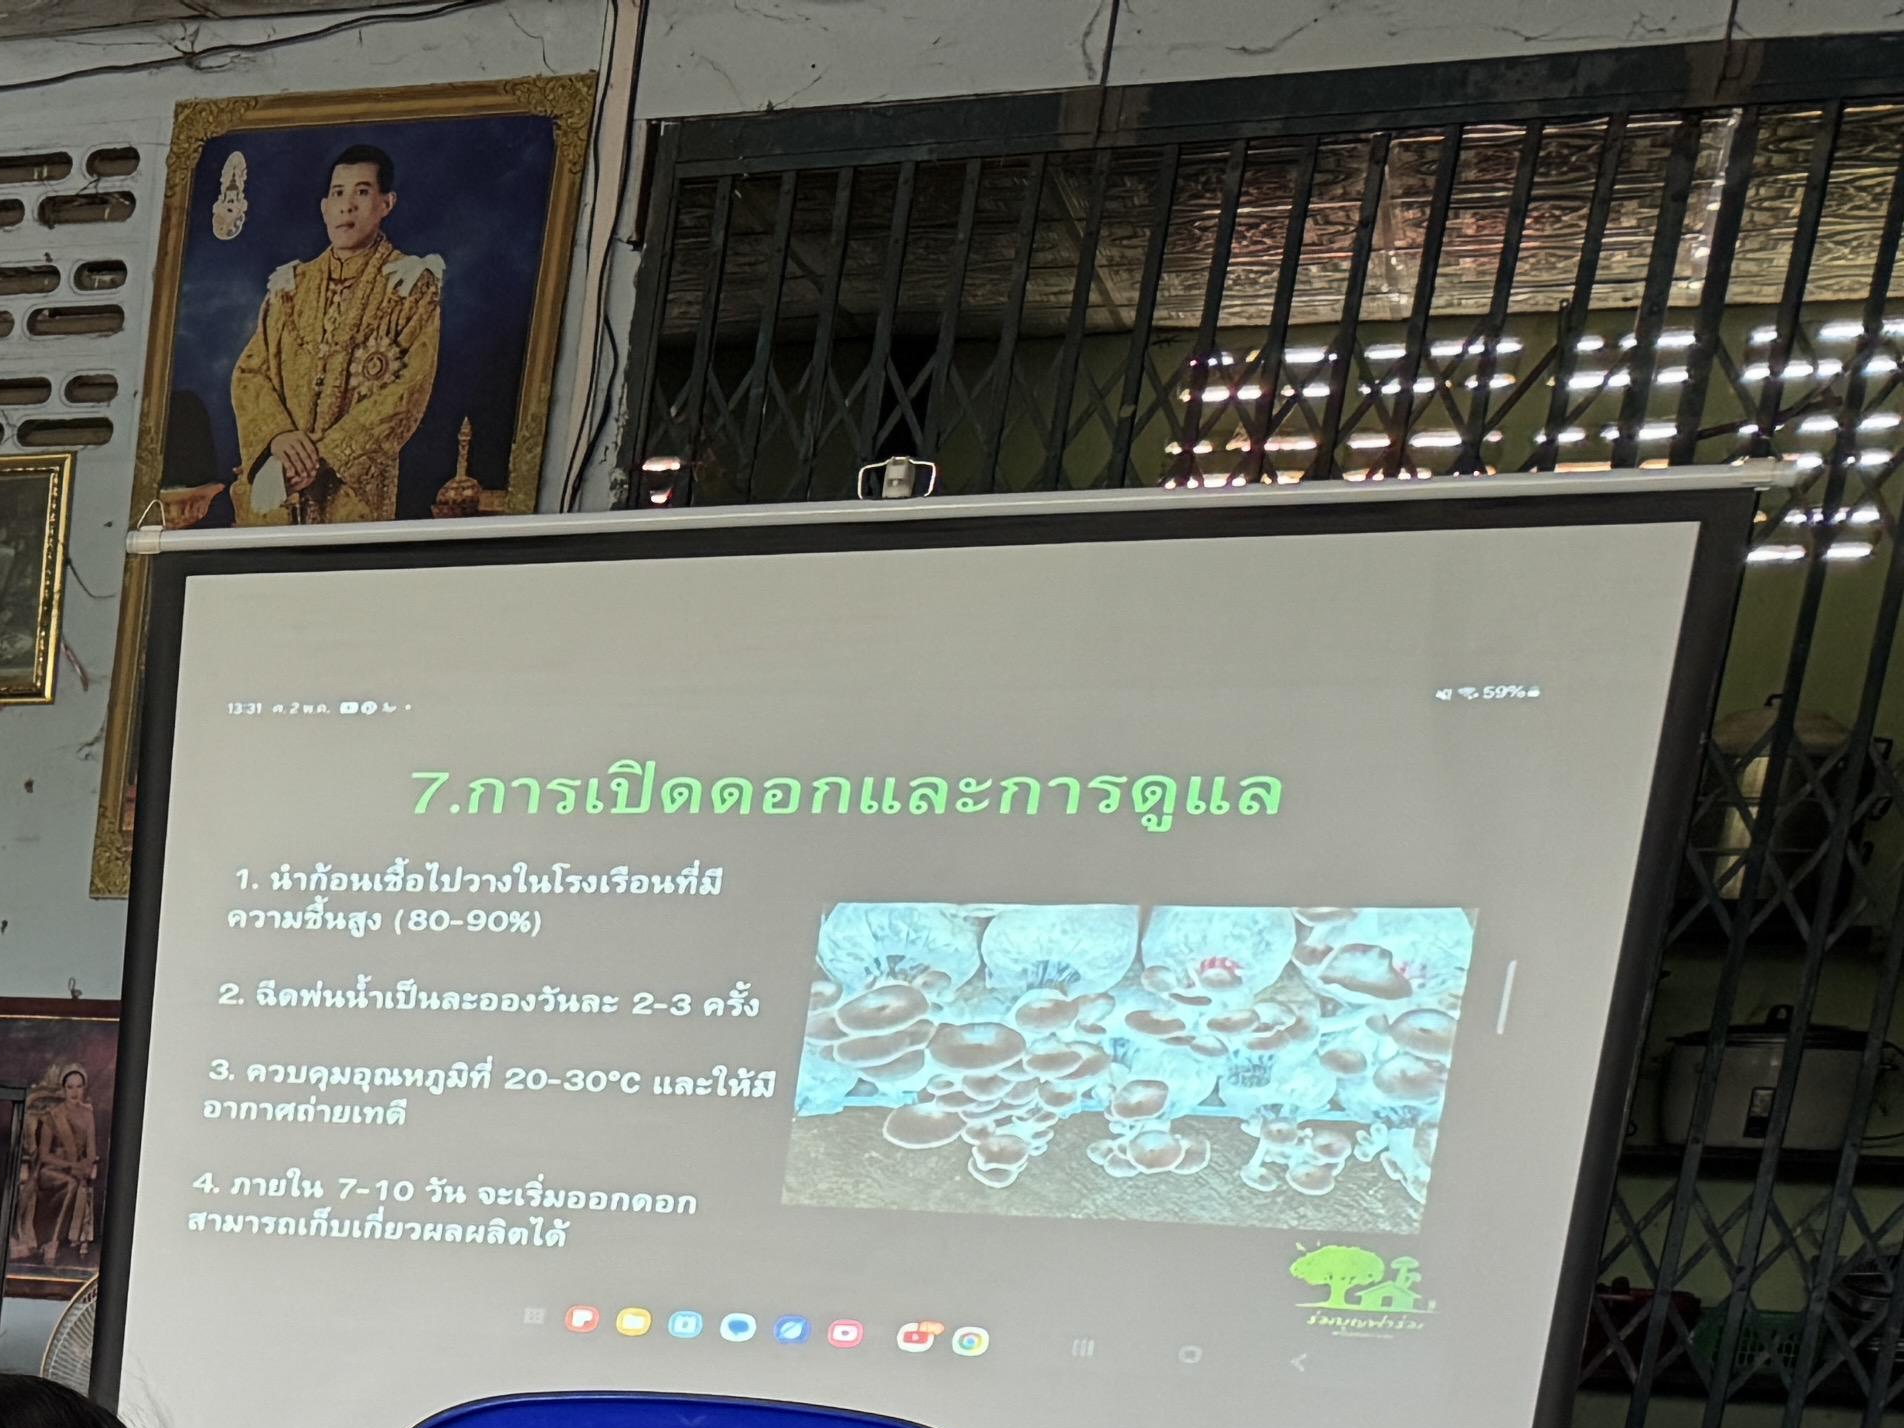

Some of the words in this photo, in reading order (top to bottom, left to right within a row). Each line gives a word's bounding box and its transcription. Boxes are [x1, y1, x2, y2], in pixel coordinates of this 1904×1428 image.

[411, 759, 1284, 833] 7.การเปิดดอกและการดูแล
[236, 868, 260, 892] 1.
[271, 857, 723, 896] นำก้อนเชื้อไปวางในโรงเรือนที่มี
[228, 896, 382, 938] ความชื้นสูง
[394, 909, 542, 937] (80-90%)
[218, 983, 245, 1006] 2.
[256, 974, 619, 1015] ฉีดพ่นน้ำเป็นละอองวันละ
[633, 993, 692, 1016] 2-3
[704, 981, 761, 1018] ครั้ง
[209, 1058, 235, 1082] 3.
[247, 1057, 493, 1095] ควบคุมอุณหภูมิที่
[504, 1068, 641, 1095] 20-30°C
[654, 1065, 776, 1099] และให้มี
[203, 1096, 408, 1126] อากาศถ่ายเทดี
[193, 1171, 221, 1195] 4.
[231, 1168, 323, 1200] ภายใน
[339, 1178, 414, 1203] 7-10
[426, 1177, 467, 1205] วัน
[478, 1174, 698, 1216] จะเริ่มออกดอก
[187, 1209, 571, 1248] สามารถเก็บเกี่ยวผลผลิตได้
